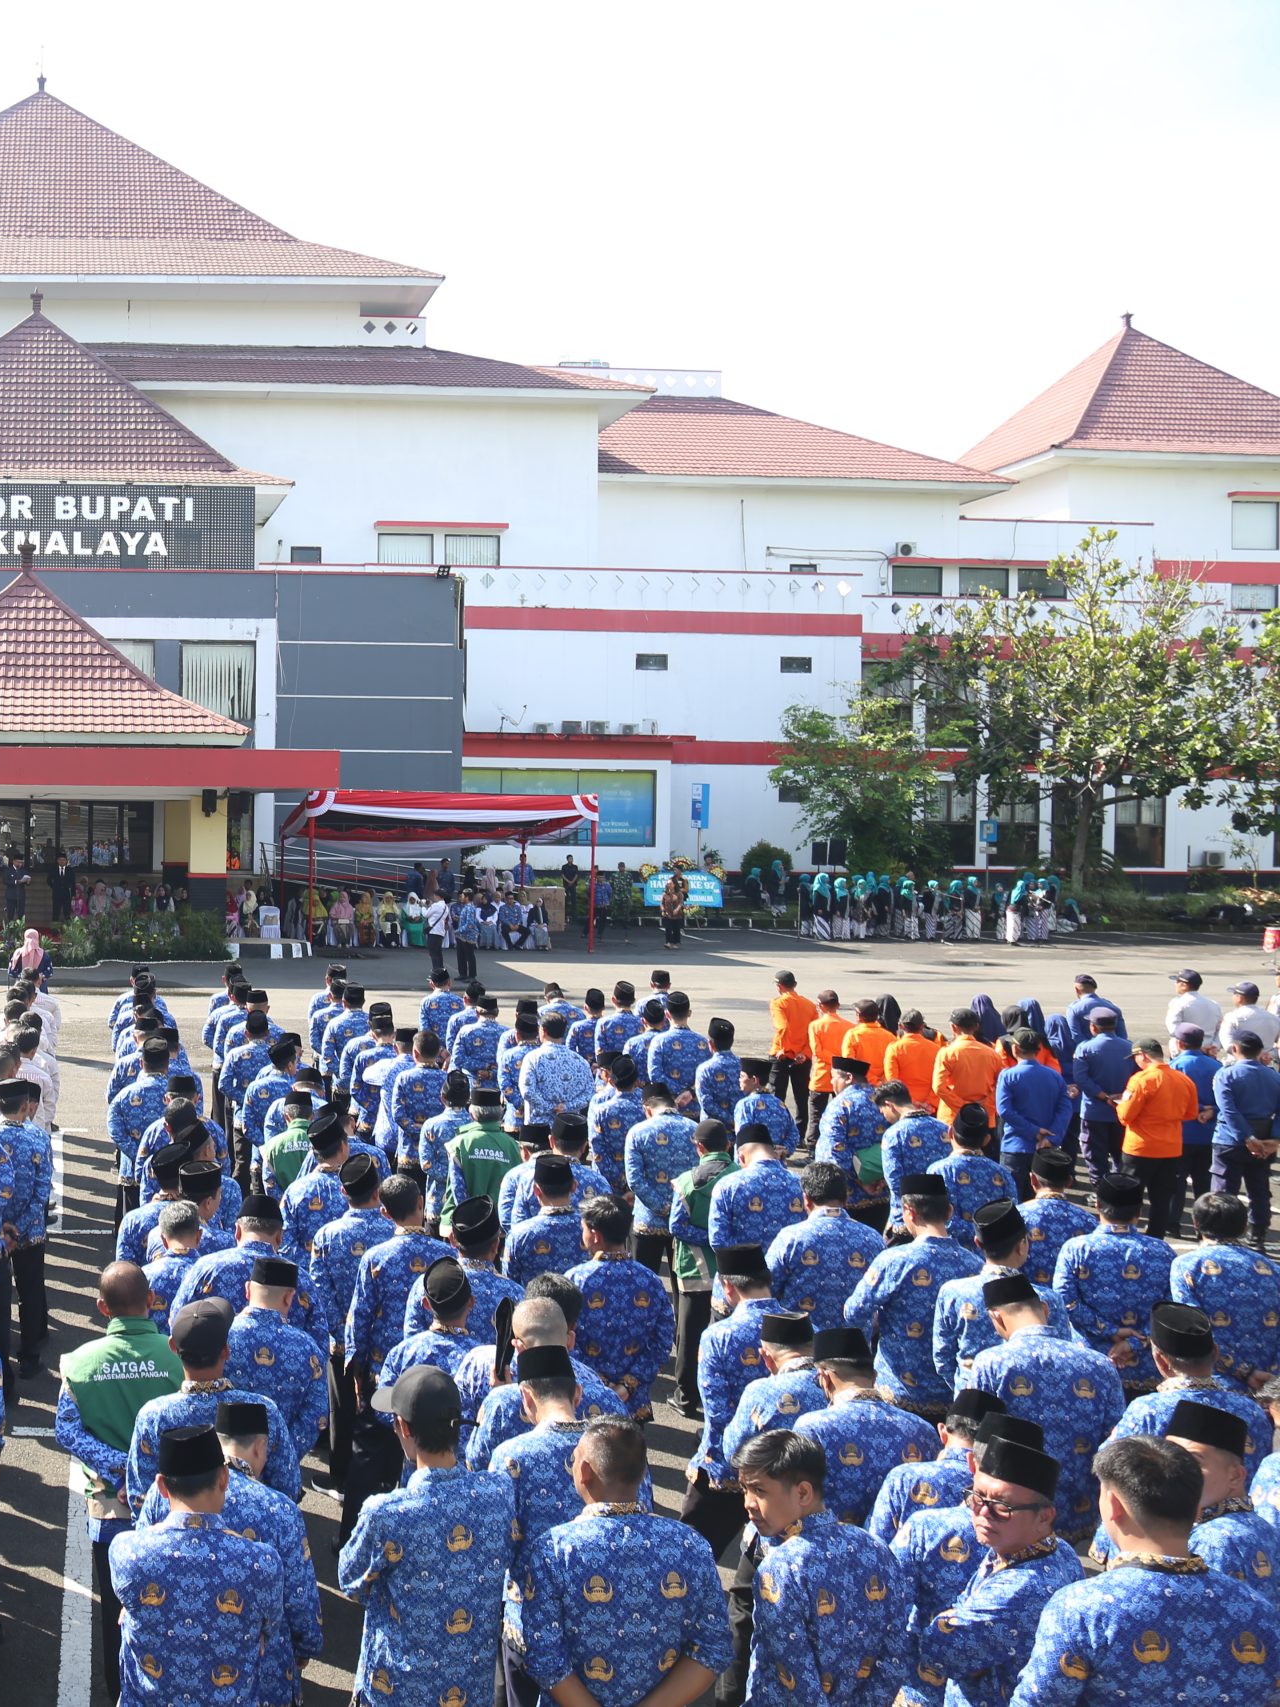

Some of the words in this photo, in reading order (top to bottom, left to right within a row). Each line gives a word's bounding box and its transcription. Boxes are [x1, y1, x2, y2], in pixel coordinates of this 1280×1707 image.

[55, 496, 194, 522] BUPATI
[982, 823, 994, 839] P
[703, 882, 716, 890] 97
[474, 1147, 505, 1158] SATGAS
[102, 1360, 155, 1374] SATGAS
[93, 1372, 140, 1382] SWASEMBADA
[140, 1371, 169, 1379] PANGAN
